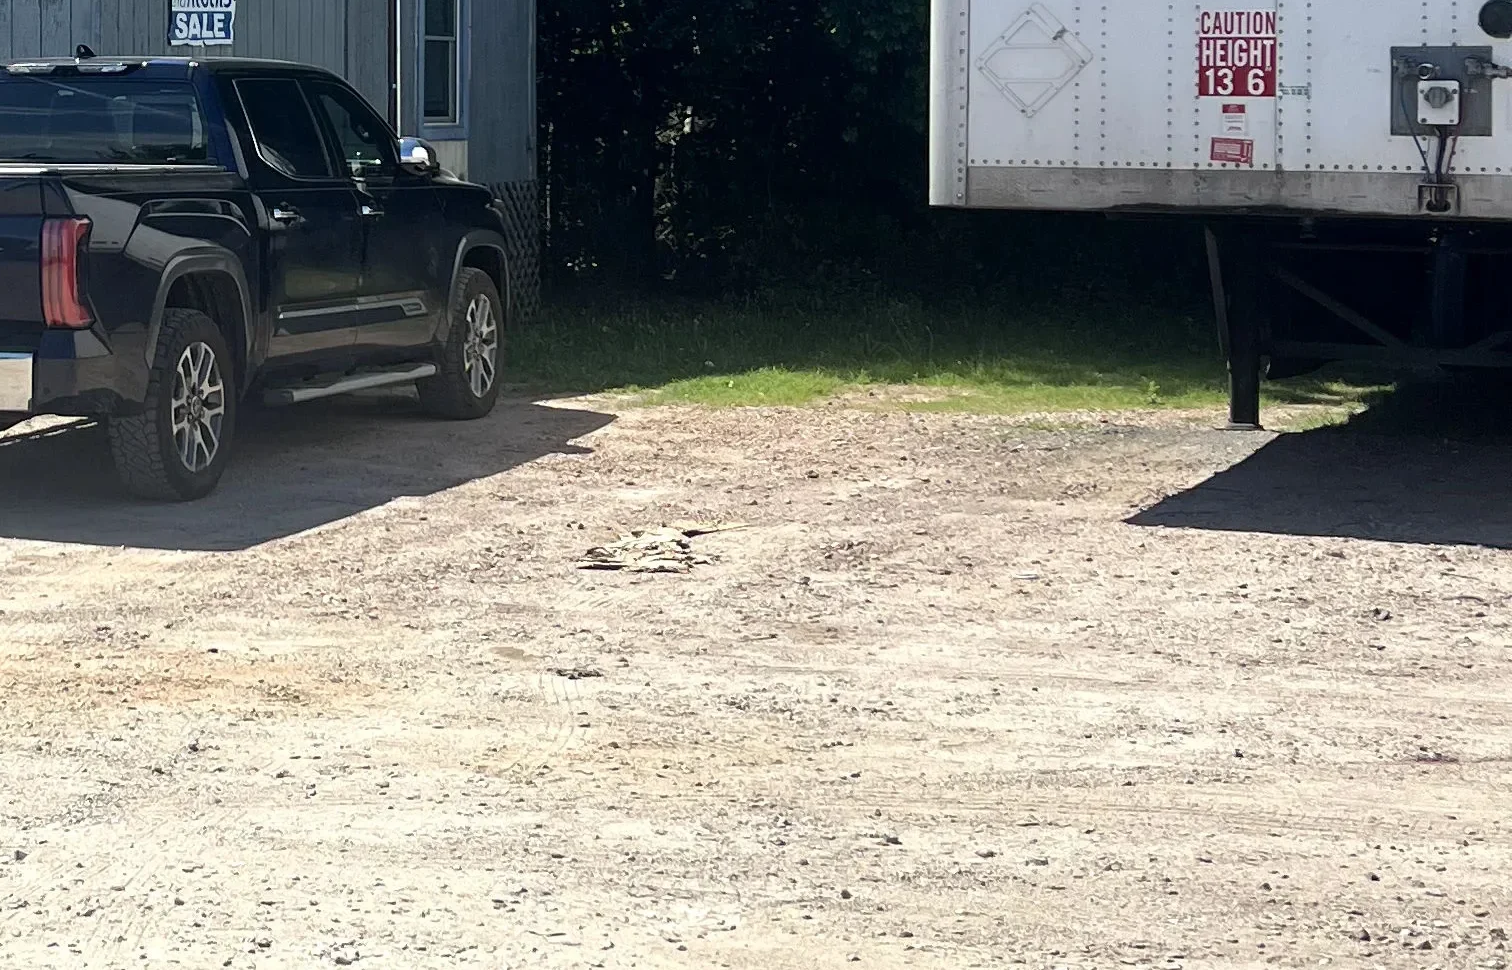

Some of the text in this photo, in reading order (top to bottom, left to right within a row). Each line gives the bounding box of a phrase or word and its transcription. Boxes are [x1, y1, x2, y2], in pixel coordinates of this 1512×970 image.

[175, 12, 226, 39] SALE
[1201, 11, 1276, 35] CAUTION
[1201, 39, 1275, 67] HEIGHT
